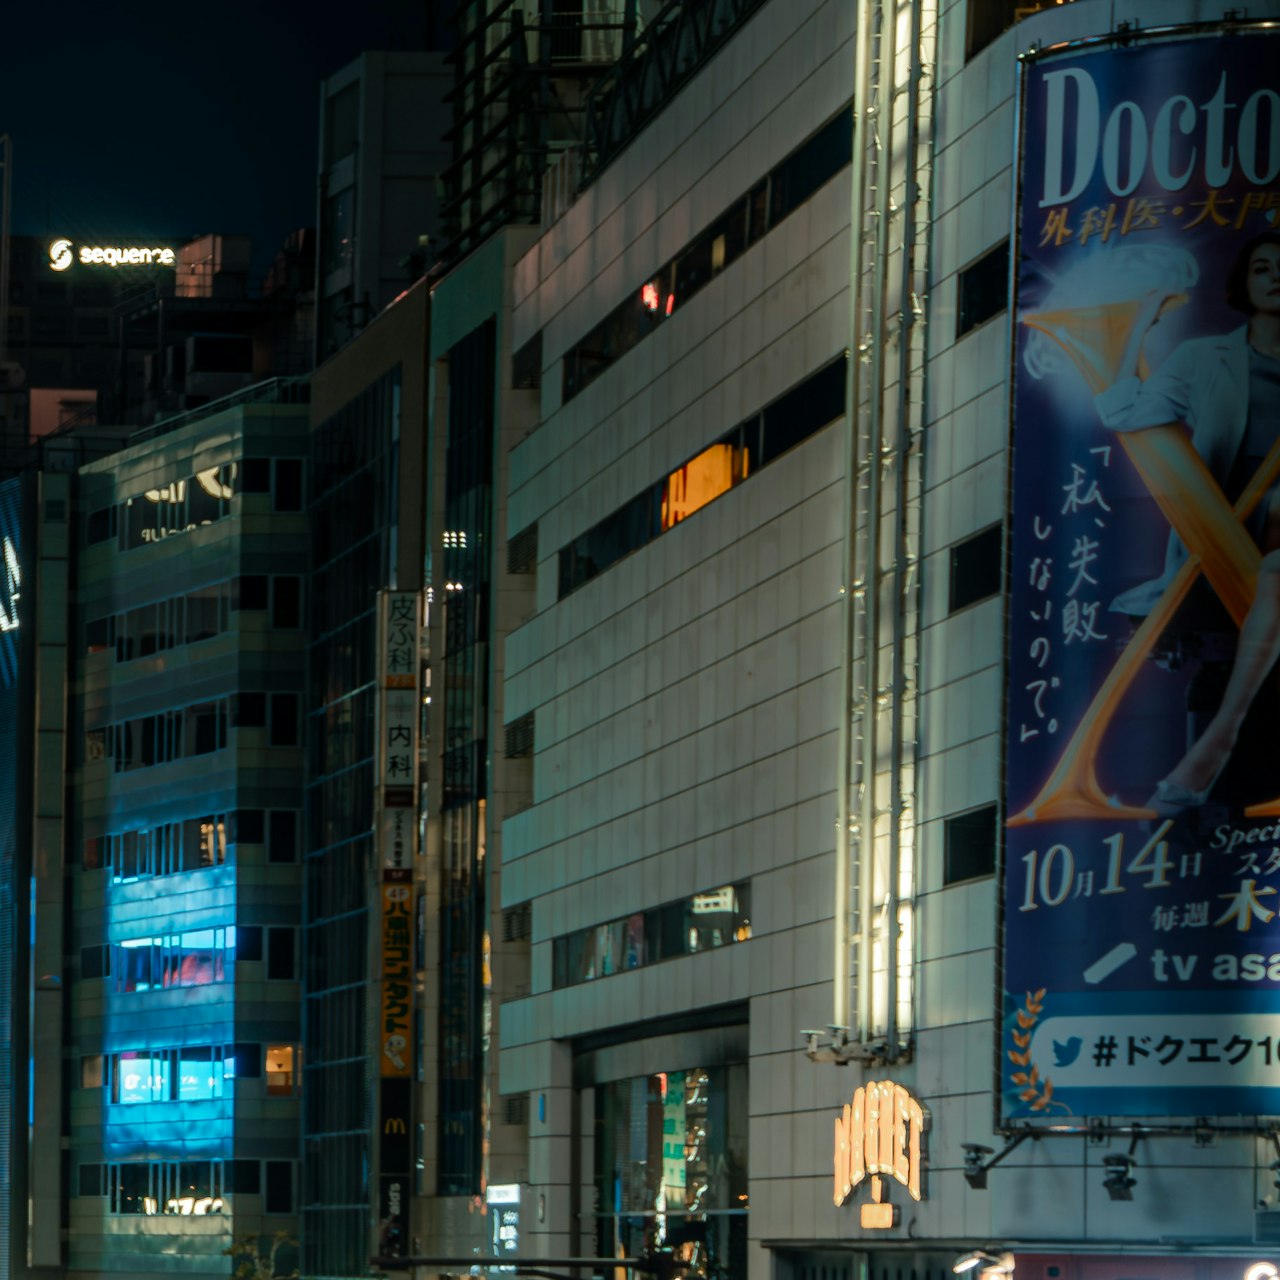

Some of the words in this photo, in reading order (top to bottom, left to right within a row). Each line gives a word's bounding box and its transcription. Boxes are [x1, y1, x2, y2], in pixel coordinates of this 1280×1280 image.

[79, 245, 176, 265] sequence
[388, 595, 415, 673] 皮ふ科
[388, 724, 411, 778] 内科
[1018, 819, 1202, 913] 10月14日
[1151, 949, 1198, 982] tv
[1093, 1034, 1280, 1069] #ドクエク1
